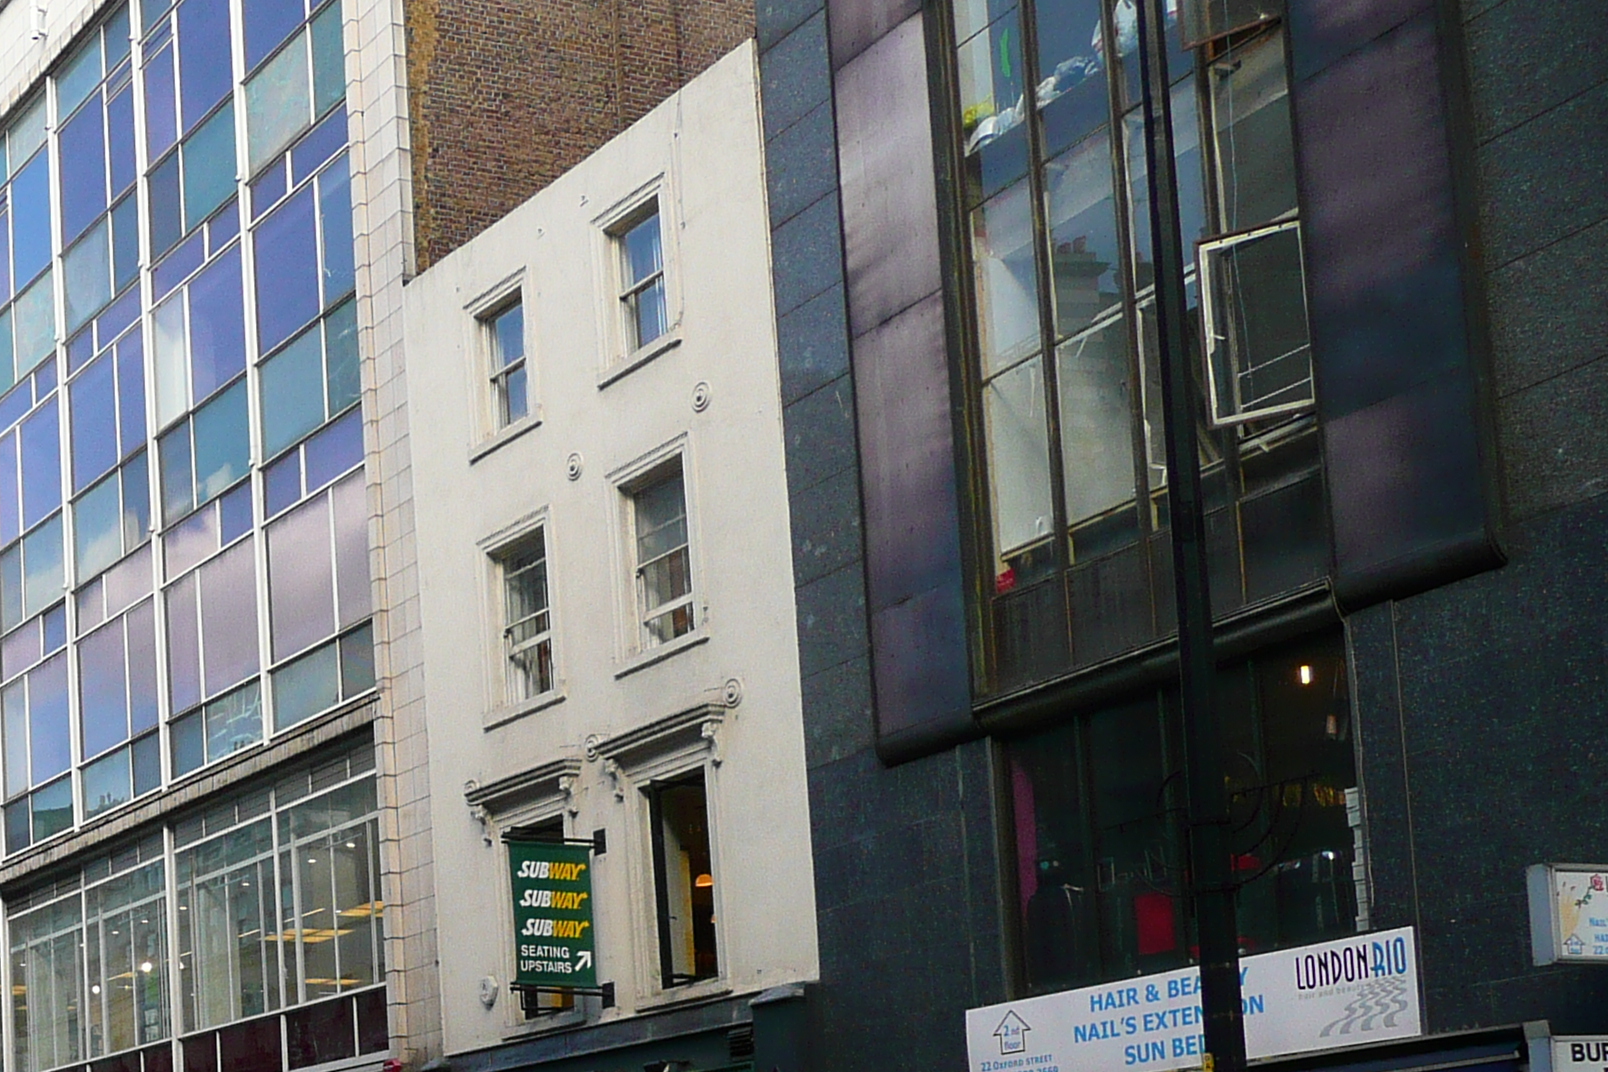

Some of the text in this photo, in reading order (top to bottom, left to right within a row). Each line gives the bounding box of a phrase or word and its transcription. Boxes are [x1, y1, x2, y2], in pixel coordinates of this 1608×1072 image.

[517, 860, 587, 880] SUBWAY
[519, 889, 589, 910] SUBWAY
[521, 918, 590, 939] SUBWAY
[521, 945, 570, 959] SEATING
[520, 960, 572, 974] UPSTAIRS
[1090, 966, 1249, 1012] HAIR & BEAY
[1074, 994, 1264, 1043] NAIL'S EXTENN
[981, 1062, 991, 1072] 22
[1026, 1054, 1052, 1065] STREET
[1125, 1041, 1166, 1065] SUN
